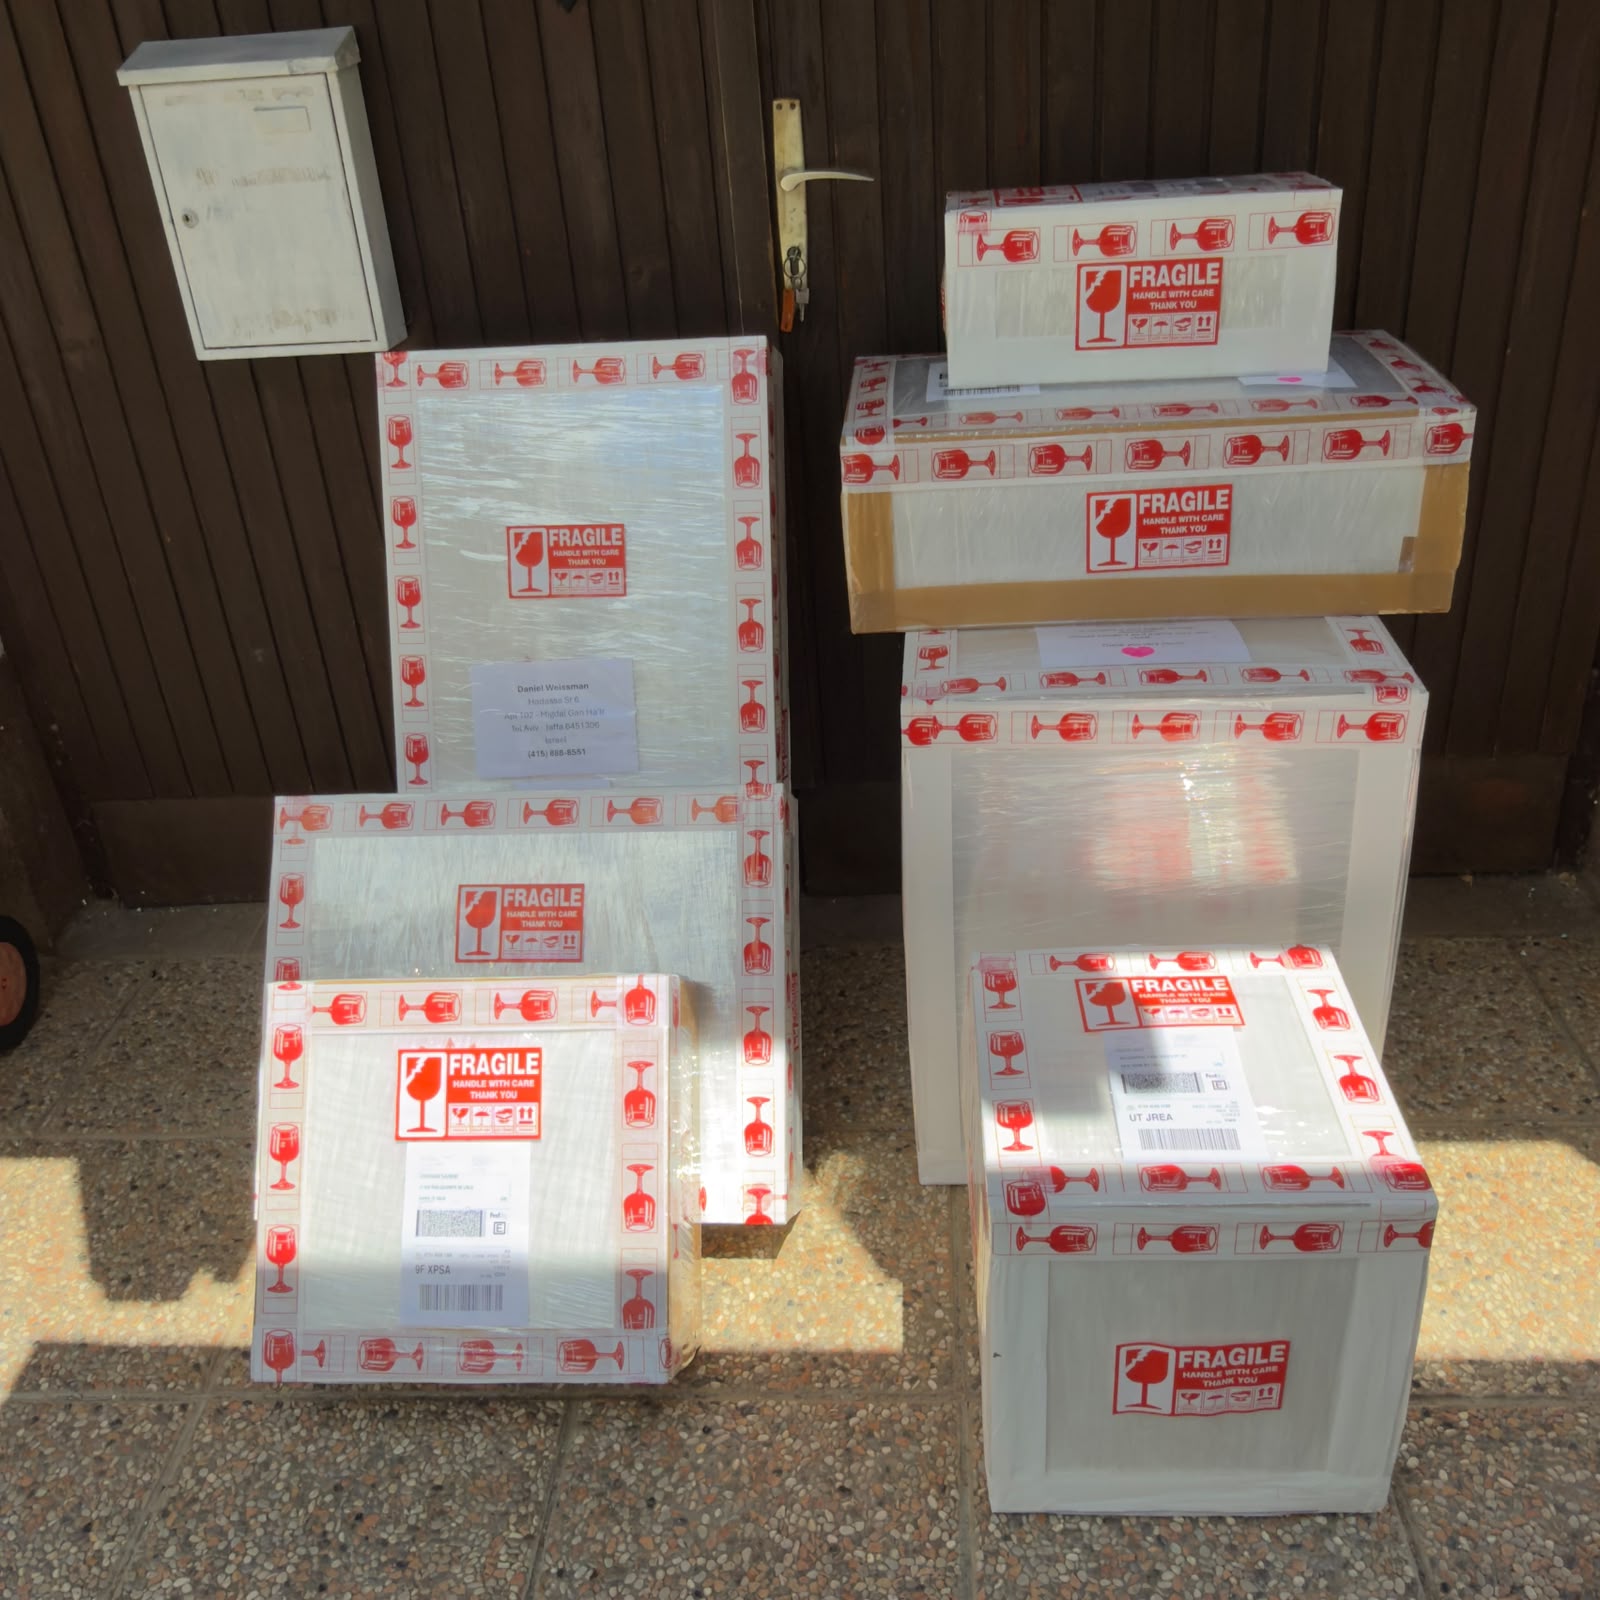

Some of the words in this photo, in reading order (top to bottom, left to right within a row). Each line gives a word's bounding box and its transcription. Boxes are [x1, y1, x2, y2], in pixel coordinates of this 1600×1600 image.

[1129, 262, 1220, 288] FRAGILE
[1133, 291, 1167, 300] HANDLE
[1169, 290, 1190, 298] WITH
[1191, 289, 1214, 297] CARE
[1150, 301, 1177, 310] THANK
[1179, 300, 1197, 309] YOU
[1139, 489, 1229, 514] FRAGILE
[1143, 516, 1176, 525] HANDLE
[1178, 515, 1200, 523] WITH
[1201, 514, 1224, 522] CARE
[1160, 526, 1187, 535] THANK
[1189, 525, 1207, 533] YOU
[549, 528, 622, 547] FRAGILE
[553, 549, 580, 557] HANDLE
[517, 685, 544, 693] Daniel
[545, 683, 589, 692] Weissman
[567, 709, 584, 717] Gan
[523, 724, 539, 732] Aviv
[503, 888, 582, 907] FRAGILE
[521, 920, 546, 928] THANK
[1131, 978, 1229, 993] FRAGILE
[449, 1053, 539, 1076] FRAGILE
[453, 1080, 487, 1088] HANDLE
[488, 1080, 510, 1088] WITH
[511, 1079, 535, 1088] CARE
[470, 1091, 498, 1099] THANK
[500, 1090, 518, 1099] YOU
[1129, 1113, 1143, 1122] UT
[1146, 1112, 1173, 1122] JREA
[415, 1264, 425, 1275] 9F
[427, 1264, 451, 1275] XPSA
[1178, 1344, 1286, 1369] FRAGILE
[1182, 1370, 1222, 1379] HANDLE
[1225, 1368, 1250, 1376] WITH
[1252, 1365, 1278, 1374] CARE
[1202, 1378, 1235, 1387] THANK
[1238, 1376, 1258, 1384] YOU
